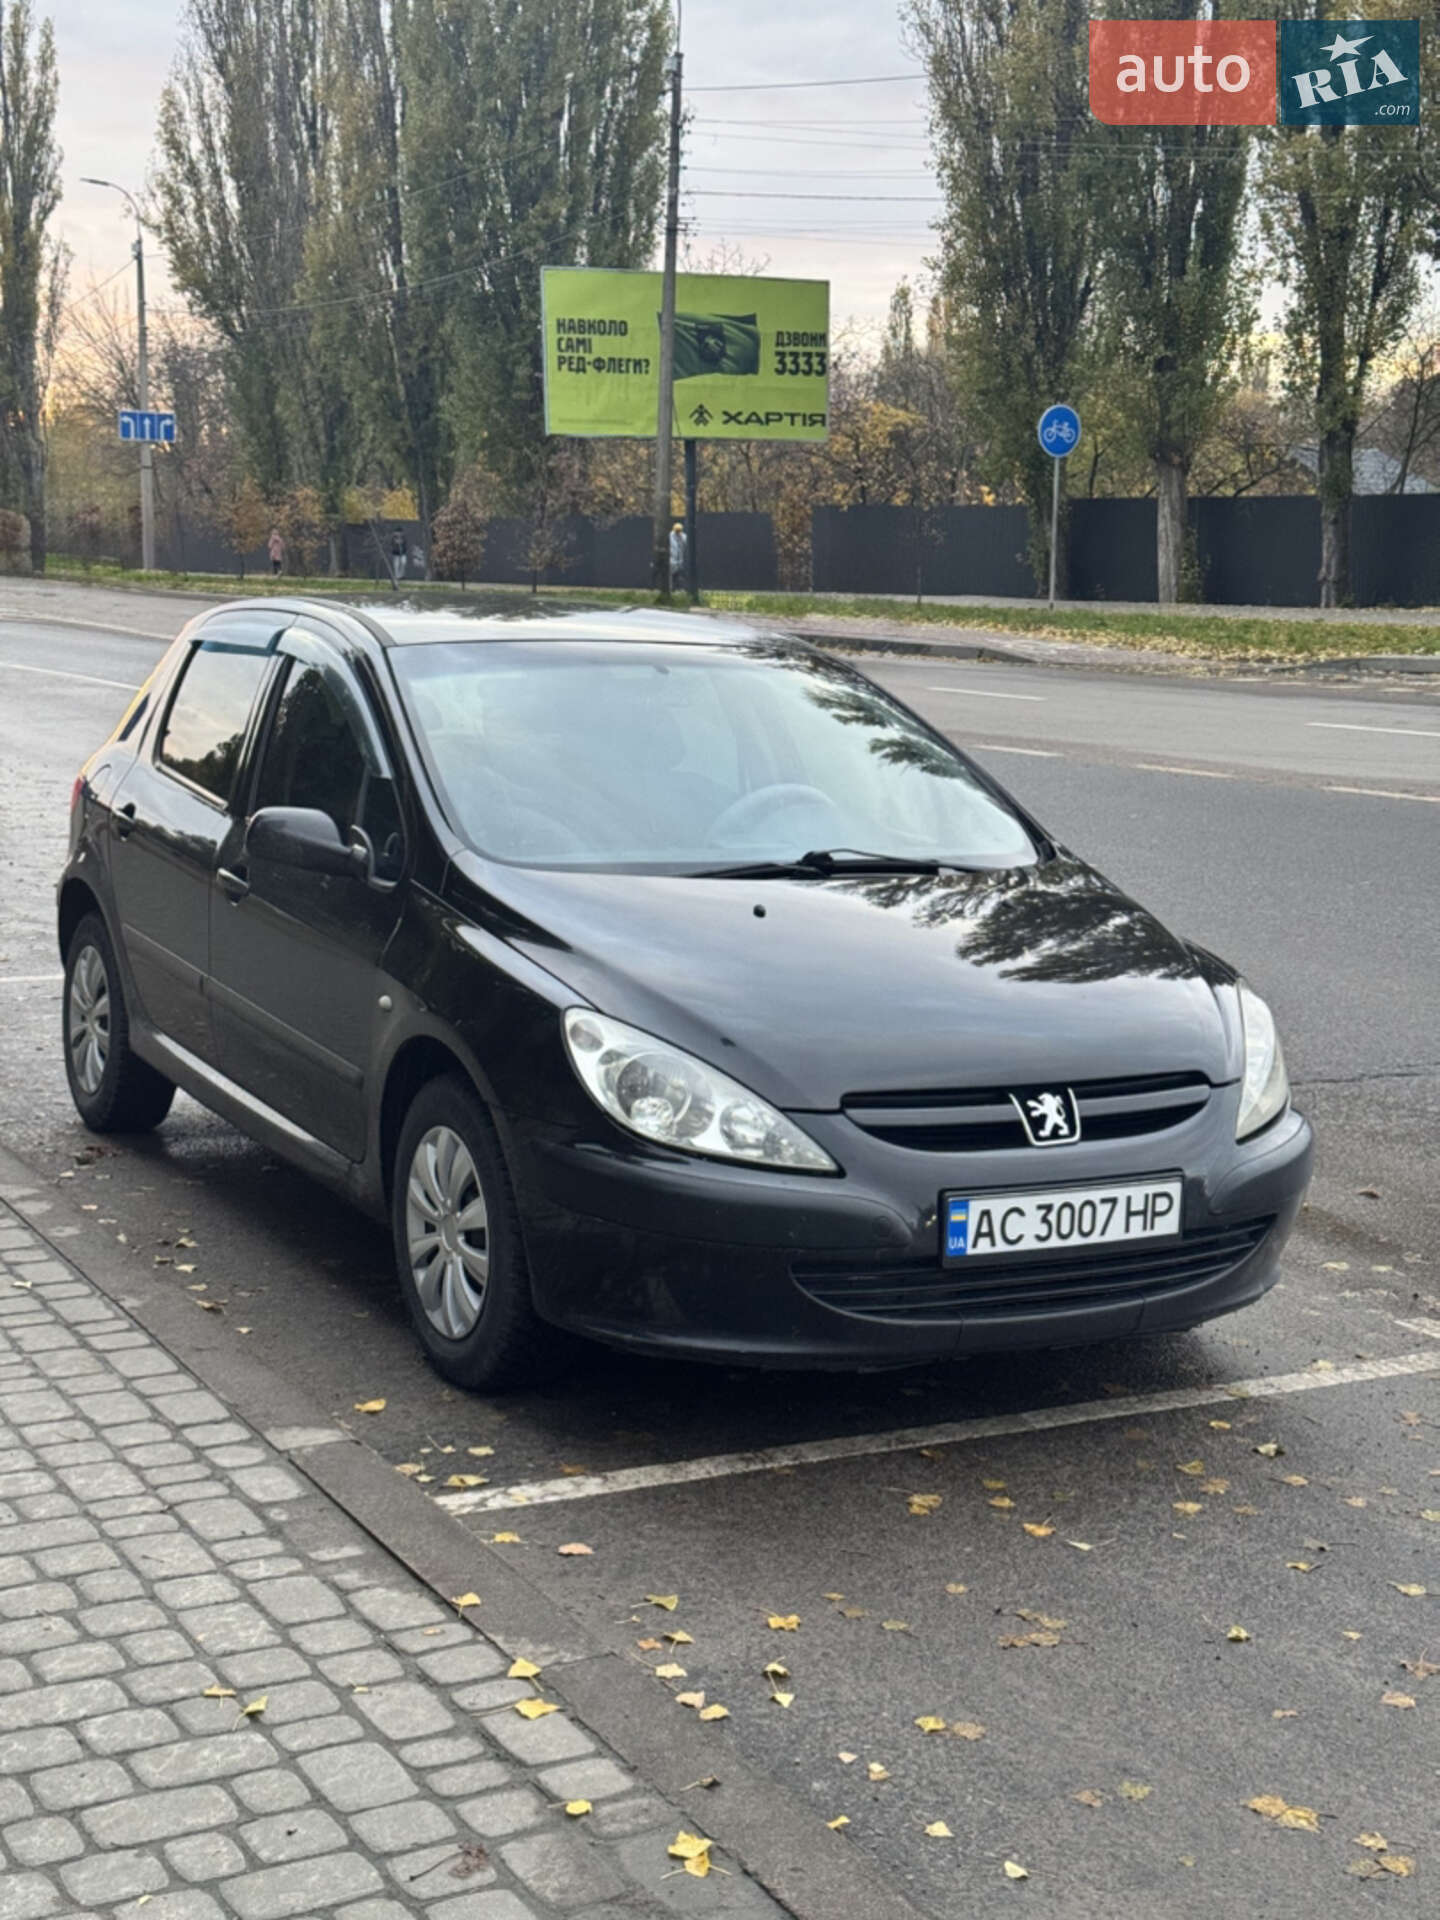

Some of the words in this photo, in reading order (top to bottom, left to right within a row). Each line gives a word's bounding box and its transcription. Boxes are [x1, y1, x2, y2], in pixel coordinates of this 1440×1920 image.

[556, 318, 628, 337] НАВКОЛО
[556, 337, 592, 354] САМІ
[774, 330, 827, 348] ДЗВОНИ
[557, 356, 651, 375] РЕД-ФЛЕГИ?
[774, 351, 827, 376] 3333
[722, 410, 827, 427] ХАРТІЯ
[1034, 1197, 1119, 1242] 3007
[948, 1237, 966, 1249] UA
